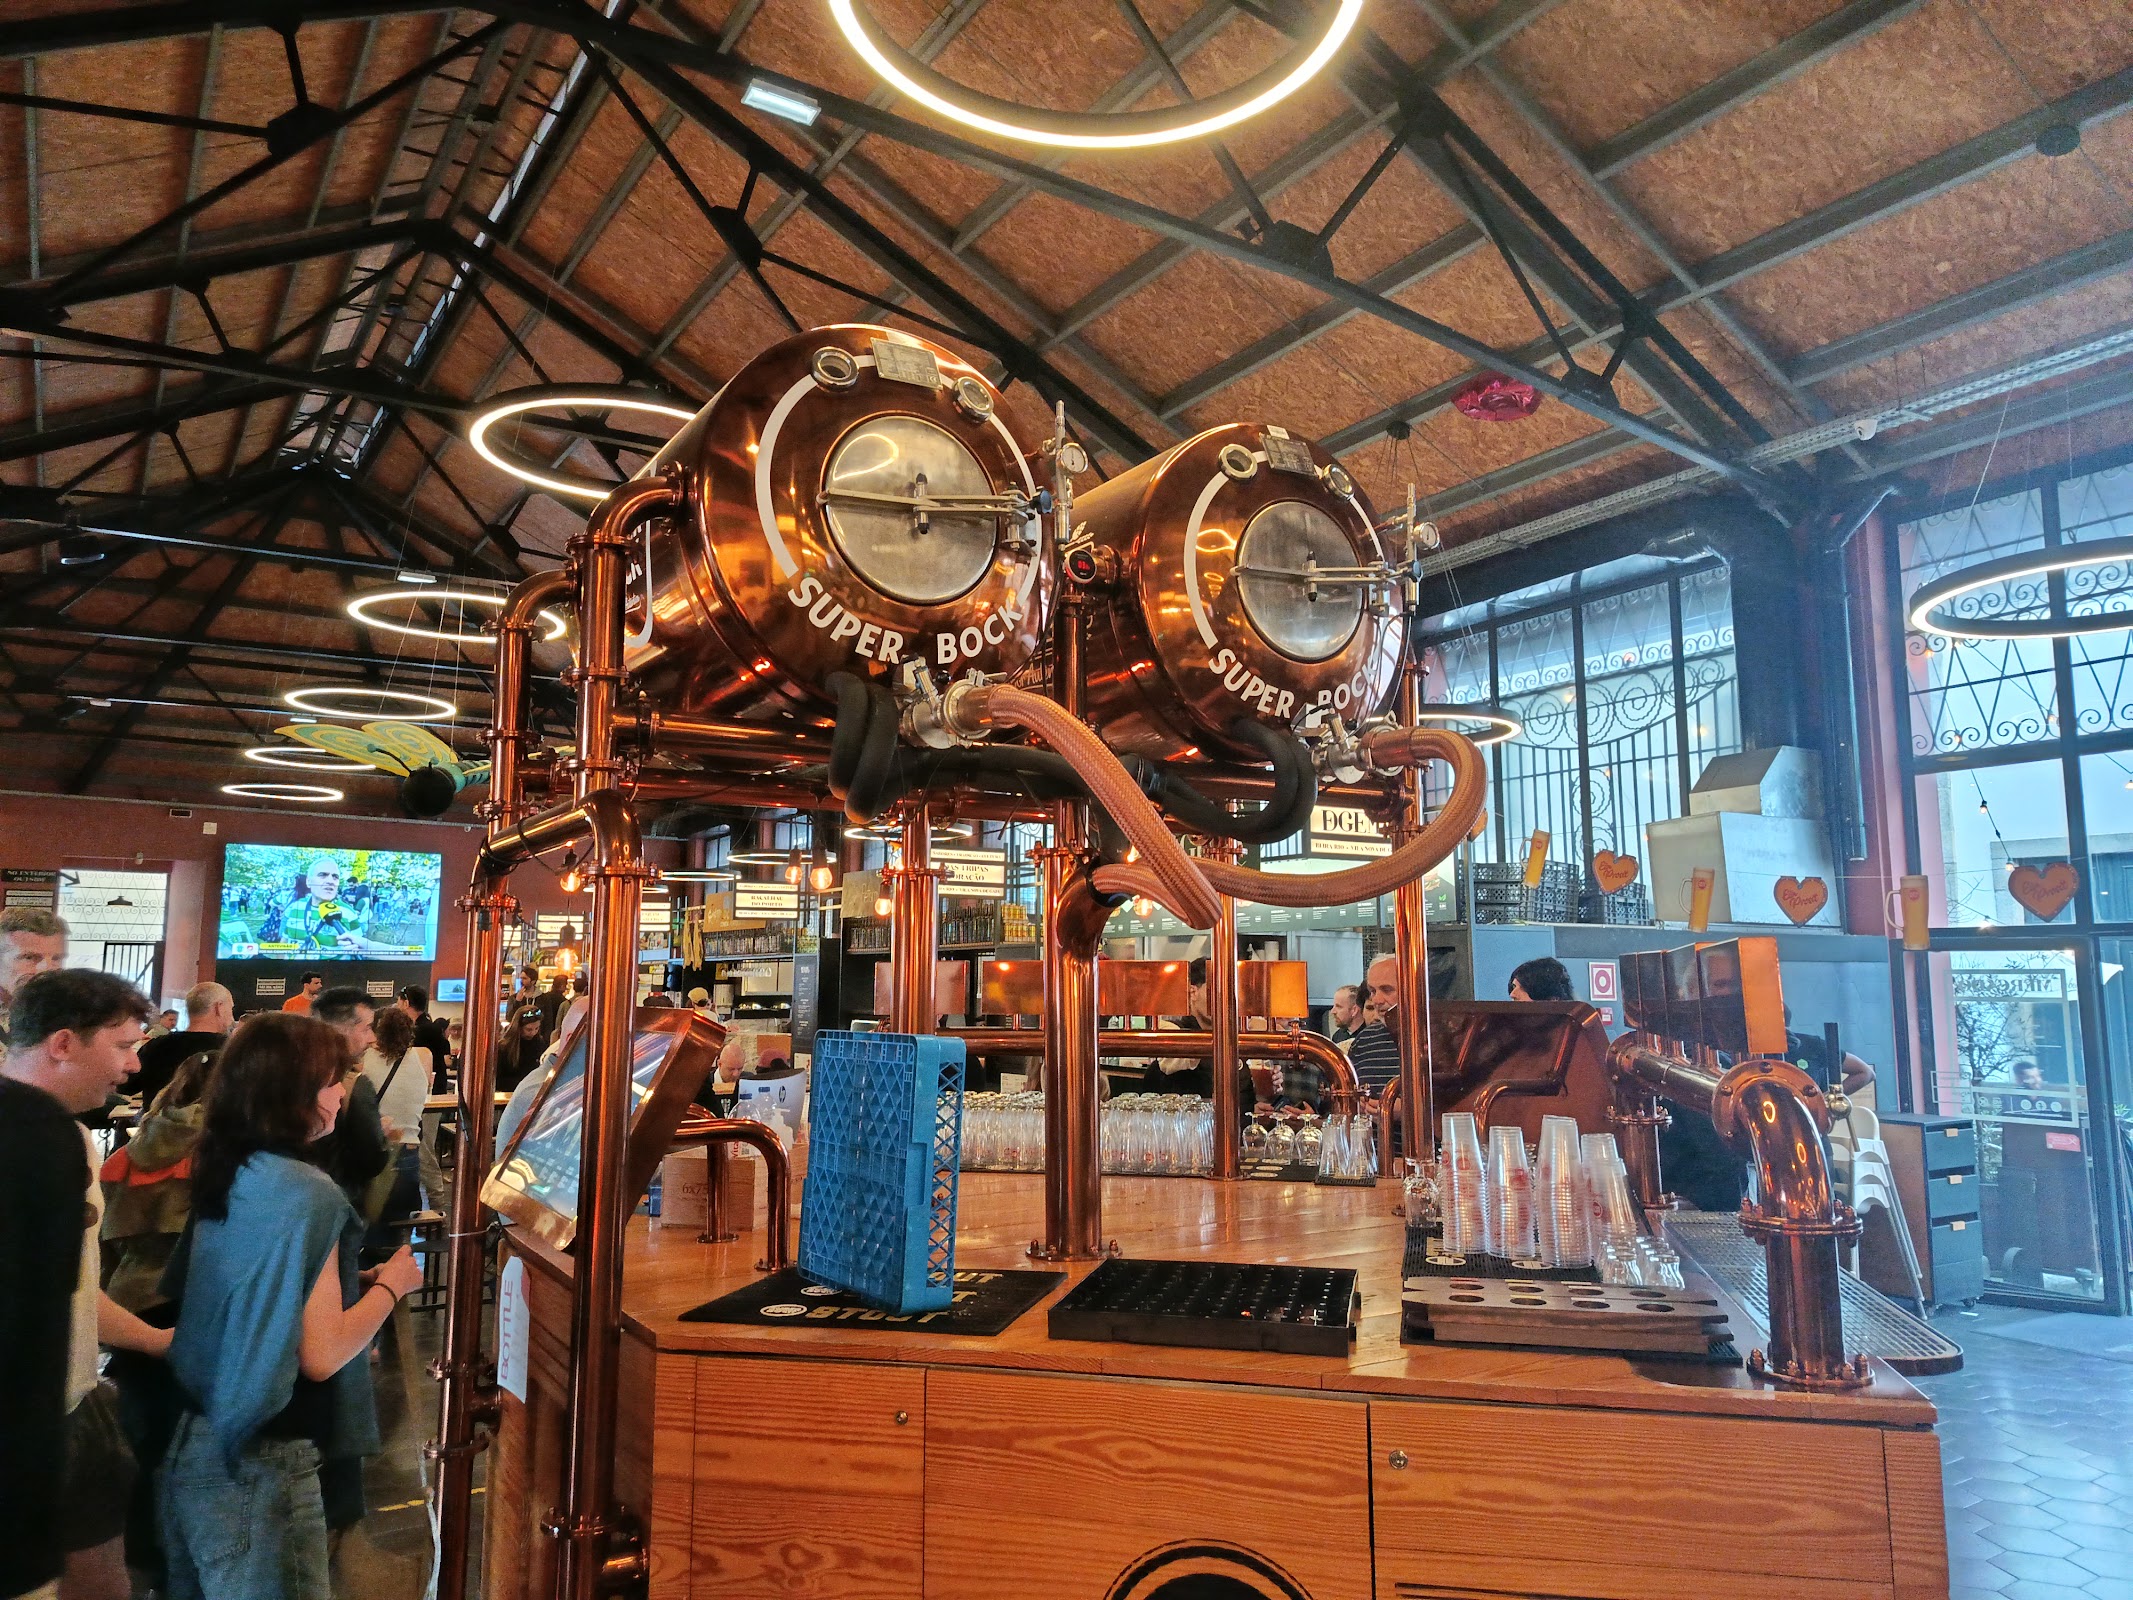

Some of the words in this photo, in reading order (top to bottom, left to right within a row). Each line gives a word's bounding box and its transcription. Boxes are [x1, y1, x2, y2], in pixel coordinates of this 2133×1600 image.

[787, 576, 904, 665] SUPER
[936, 599, 1024, 665] BOCK
[1208, 647, 1295, 719] SUPER
[501, 1279, 514, 1380] BOTTLE
